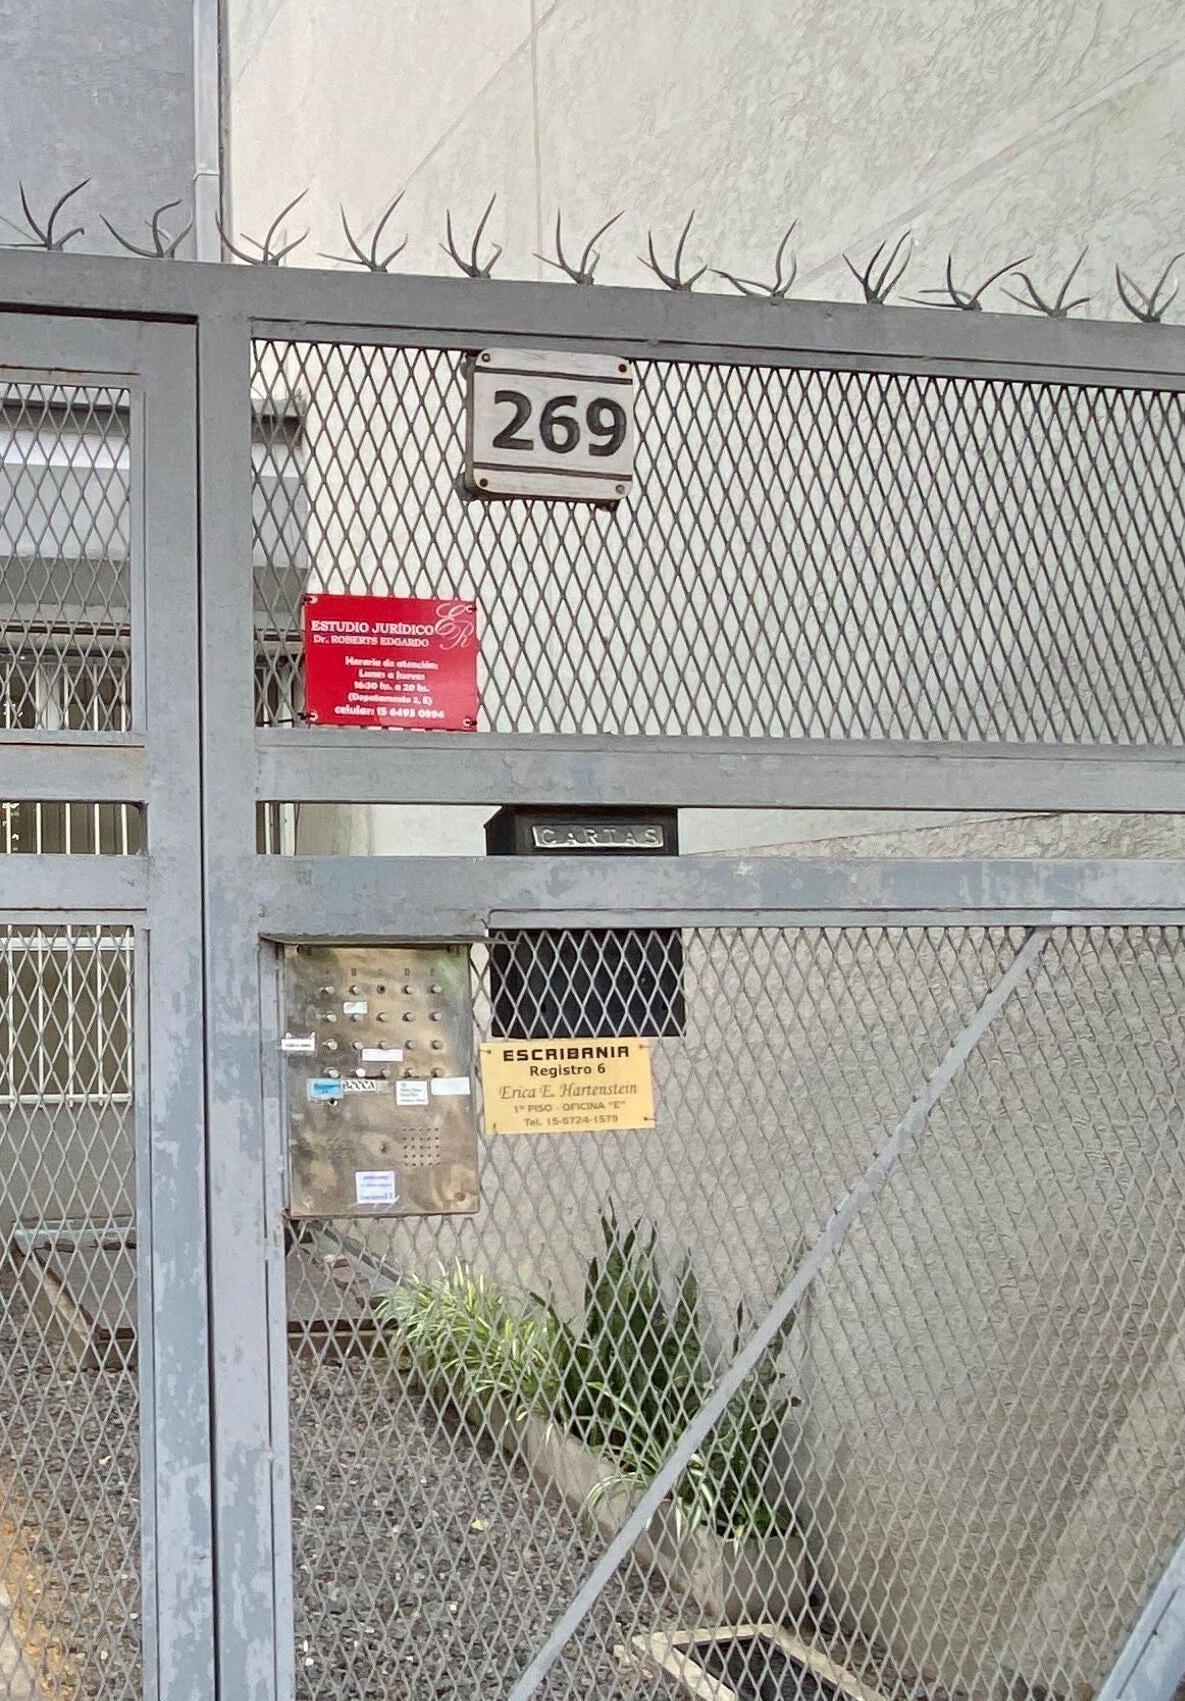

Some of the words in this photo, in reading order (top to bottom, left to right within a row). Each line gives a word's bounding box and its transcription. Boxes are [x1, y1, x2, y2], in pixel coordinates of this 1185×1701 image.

[492, 389, 627, 457] 269
[310, 620, 369, 634] ESTUDIO
[371, 621, 434, 636] JURÍDICO
[313, 634, 329, 644] Dr.
[330, 635, 378, 646] ROBERTS
[379, 637, 430, 647] EDGARDO
[382, 658, 395, 668] de
[377, 706, 388, 716] 15
[541, 828, 657, 846] CARTAS
[529, 1064, 592, 1078] Registro
[597, 1063, 606, 1074] 6
[499, 1085, 536, 1100] Erica
[539, 1086, 555, 1098] E.
[559, 1082, 637, 1098] Hartenstein
[528, 1103, 553, 1113] PISO
[562, 1101, 605, 1112] OFICINA
[524, 1117, 542, 1127] Tel.
